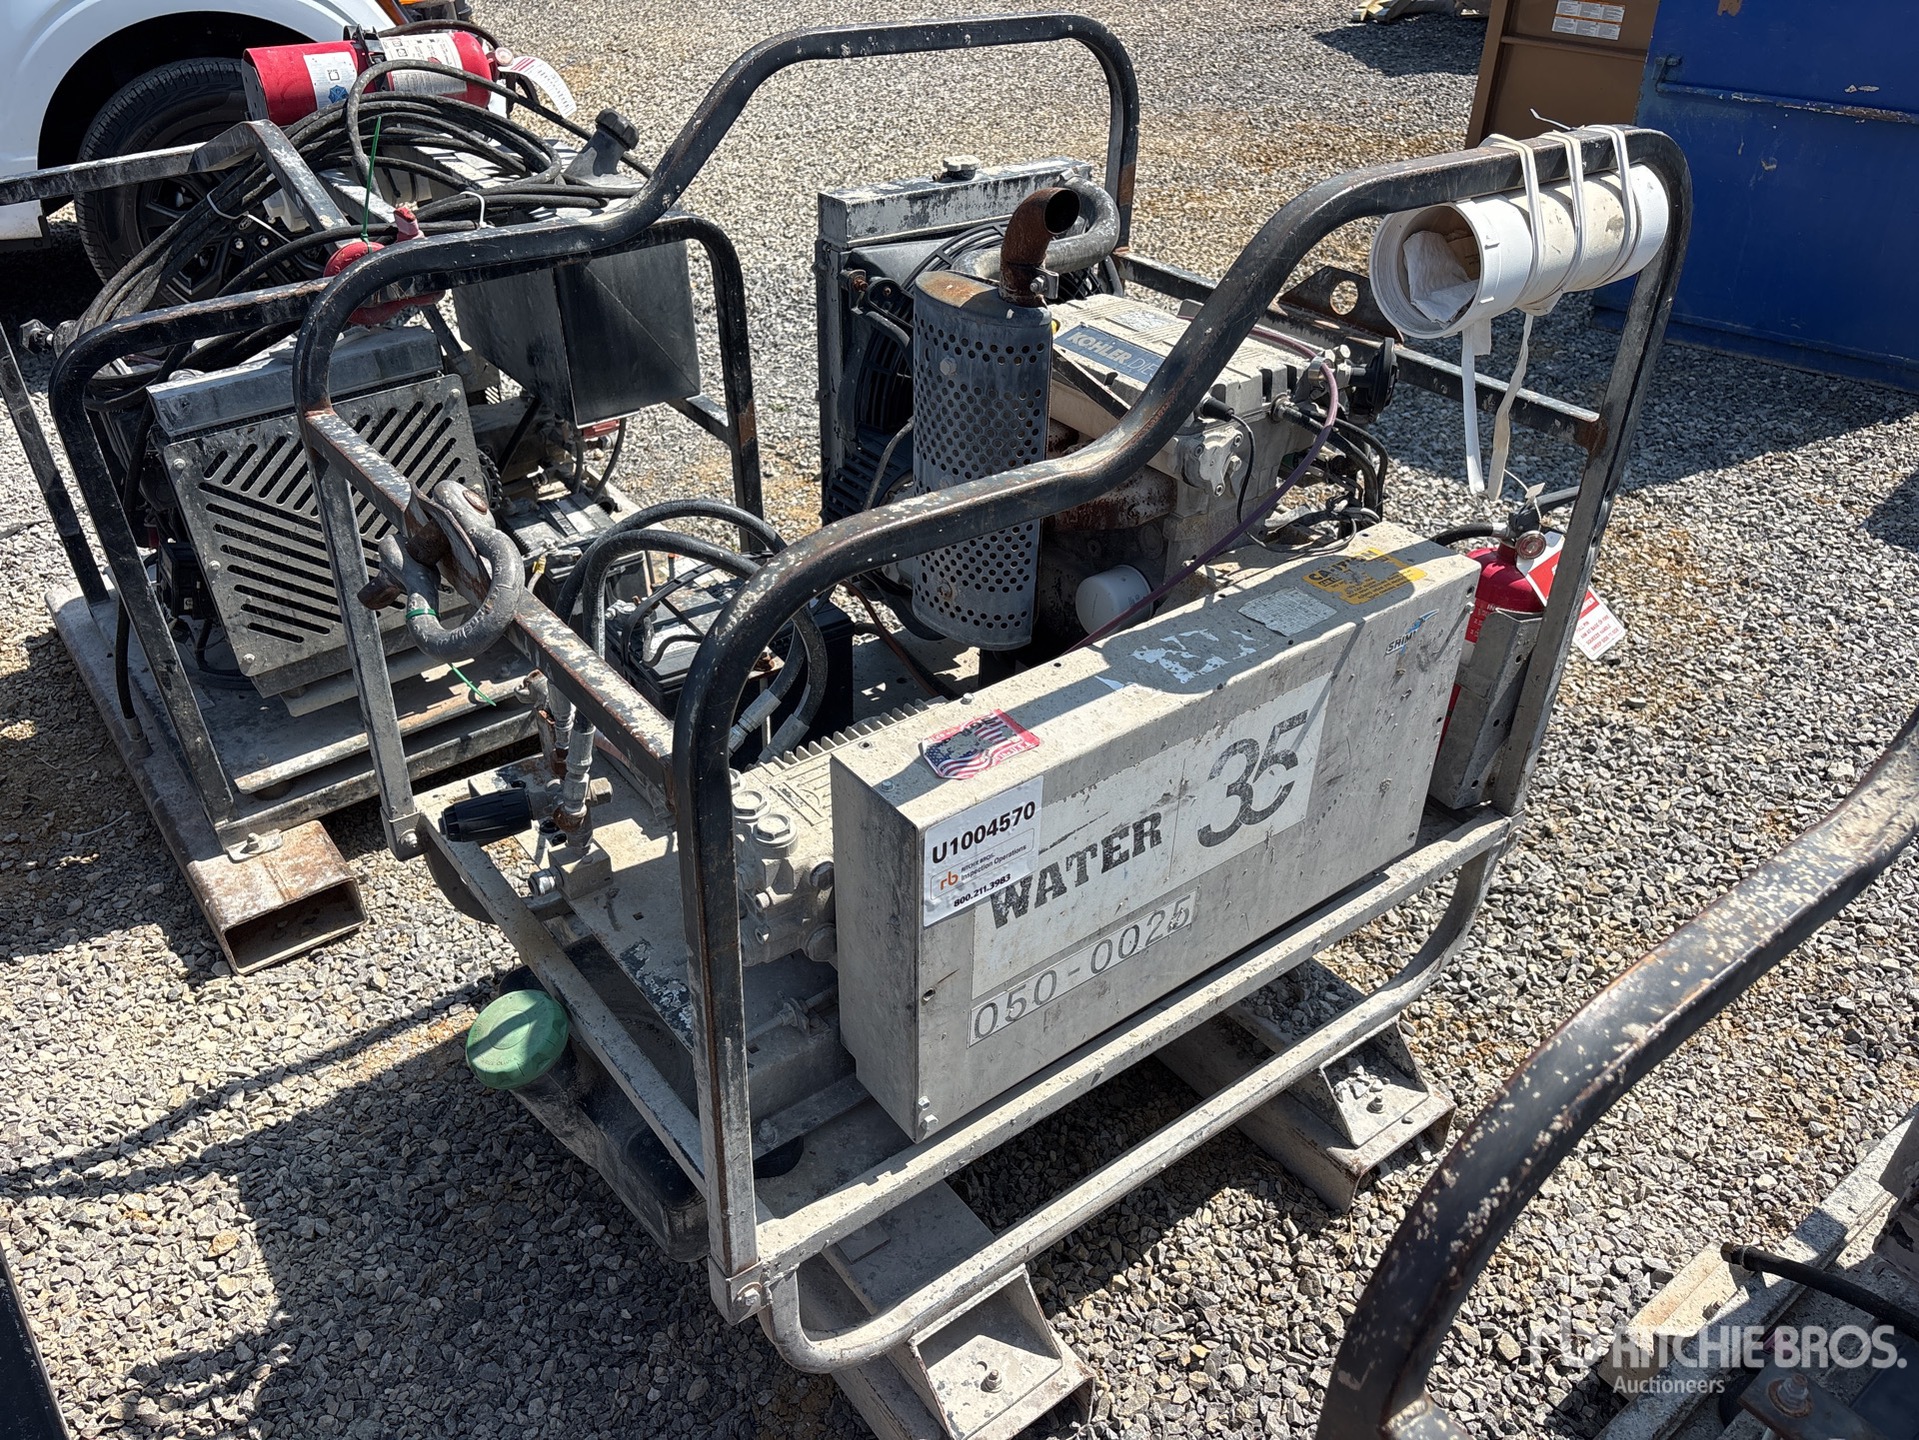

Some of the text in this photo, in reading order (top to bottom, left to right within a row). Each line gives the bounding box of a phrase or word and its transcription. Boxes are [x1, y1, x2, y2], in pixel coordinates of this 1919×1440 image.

[1127, 357, 1161, 377] DIE
[1197, 709, 1309, 848] 35
[932, 801, 1036, 864] U1004570
[940, 870, 959, 890] rb
[961, 845, 1027, 881] Inspection Operations
[990, 811, 1163, 929] WATER
[953, 873, 1011, 908] 800.211.3983
[974, 894, 1192, 1040] 050-0025
